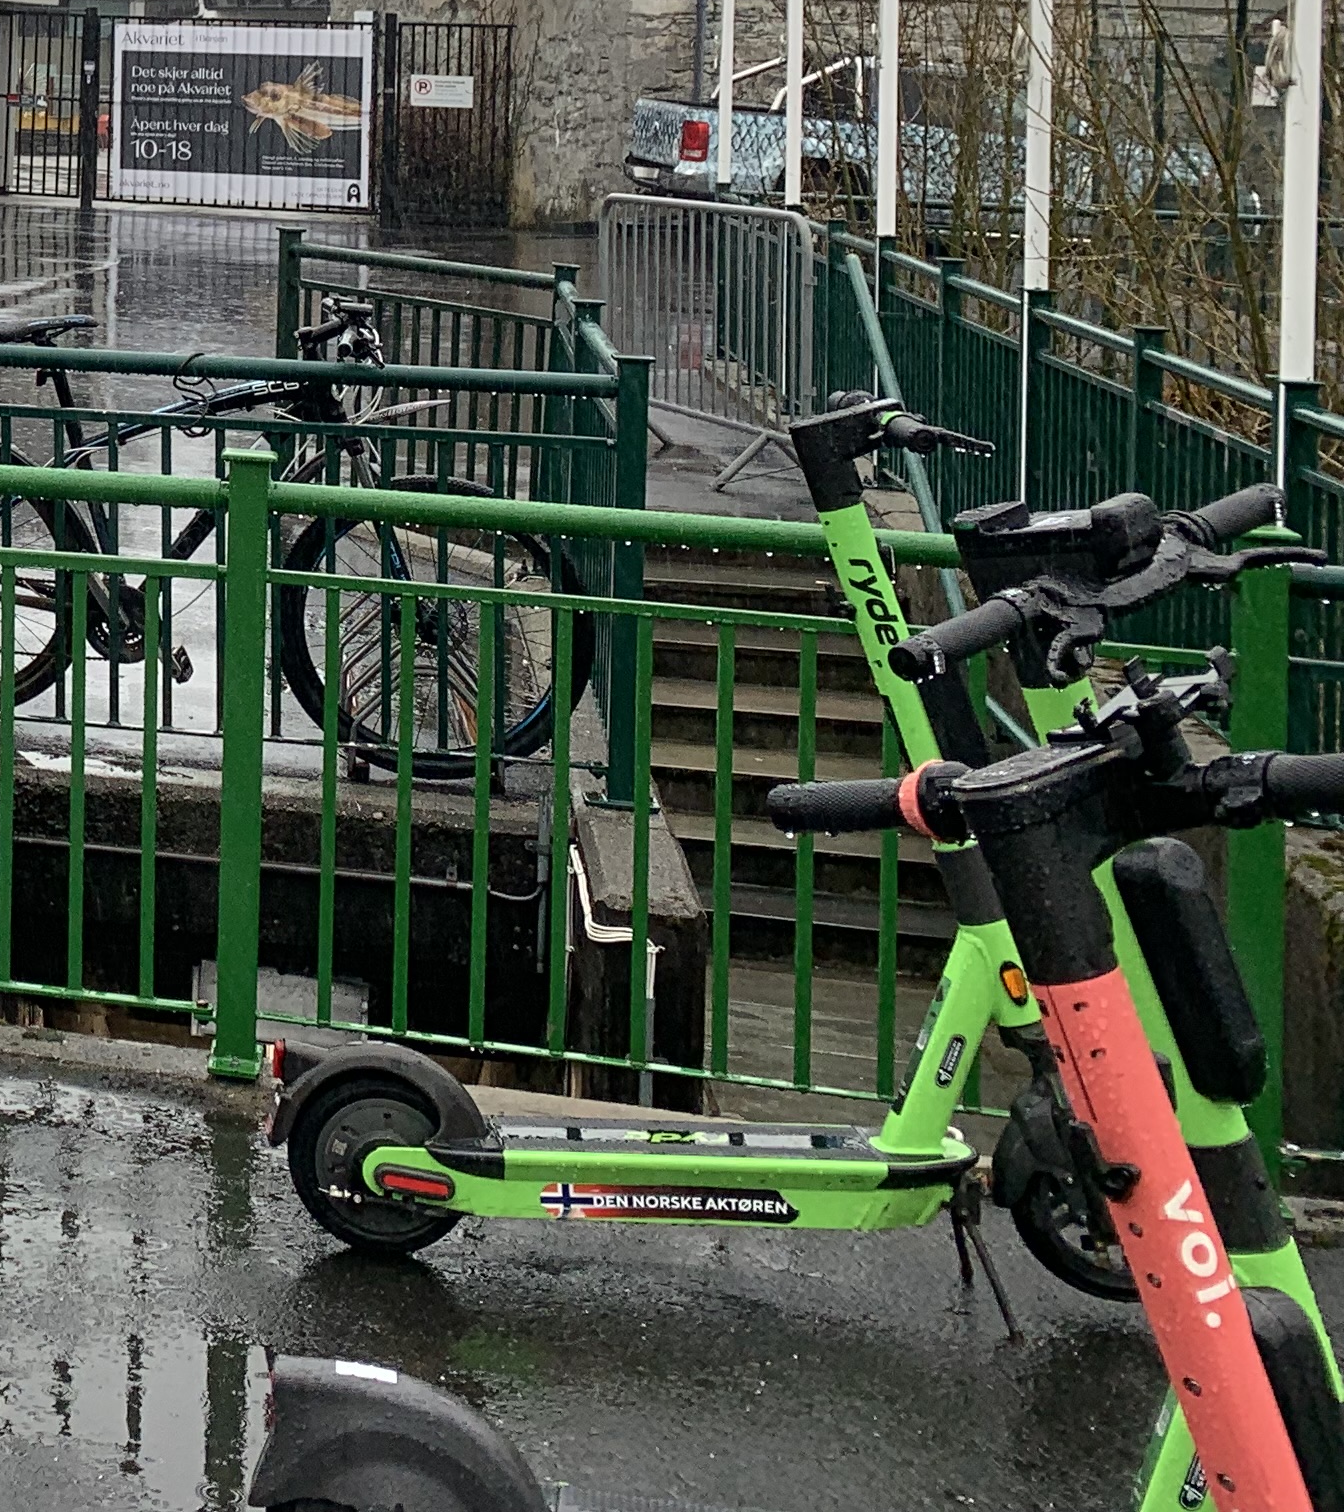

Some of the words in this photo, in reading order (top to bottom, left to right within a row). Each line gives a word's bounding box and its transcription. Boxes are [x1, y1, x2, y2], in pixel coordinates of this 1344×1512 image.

[121, 31, 185, 46] Akvariet
[132, 65, 156, 78] Det
[158, 66, 189, 80] skjer
[191, 67, 223, 80] alltid
[131, 83, 155, 93] noe
[158, 81, 175, 95] på
[177, 82, 232, 96] Akvariet
[130, 116, 172, 131] Åpent
[174, 119, 202, 132] hver
[204, 121, 229, 135] dag
[130, 139, 192, 161] 10-18
[848, 558, 900, 646] ryde
[593, 1196, 629, 1209] DEN
[632, 1195, 703, 1211] NORSKE
[705, 1198, 789, 1216] AKTØREN
